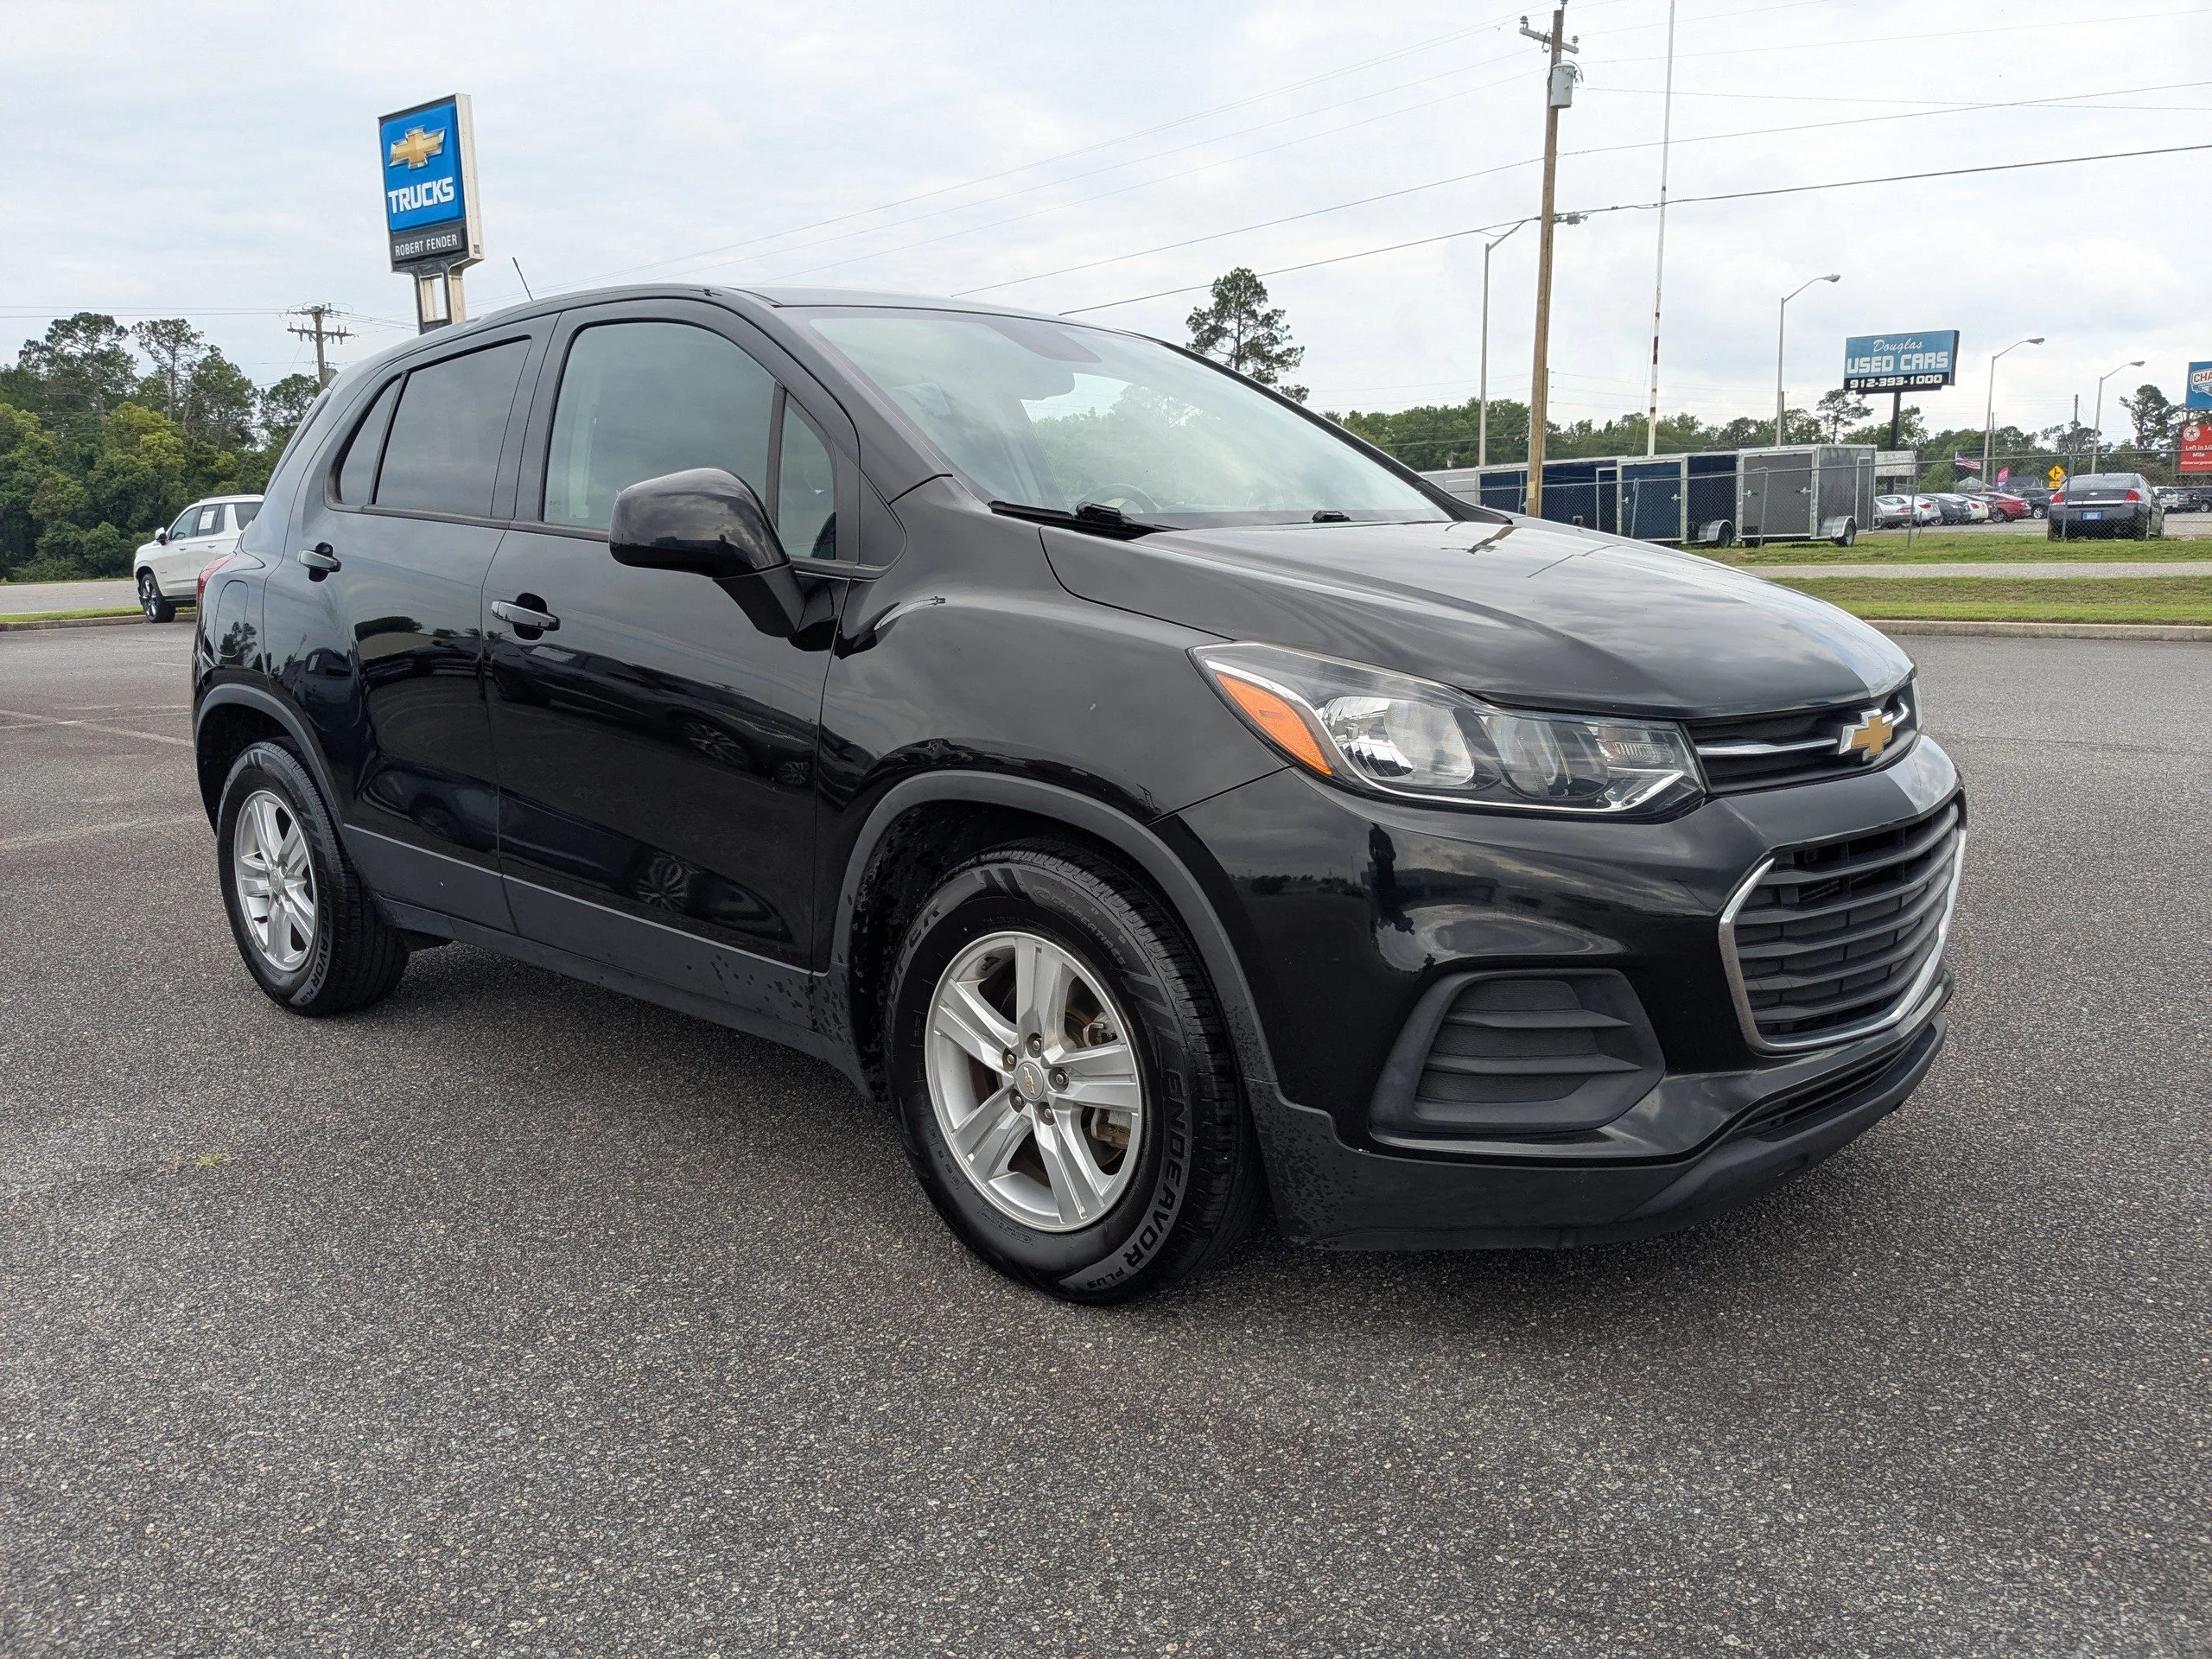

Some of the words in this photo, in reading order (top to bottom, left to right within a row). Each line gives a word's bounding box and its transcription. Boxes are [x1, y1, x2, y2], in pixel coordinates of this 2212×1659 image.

[388, 176, 454, 214] TRUCKS
[395, 239, 423, 257] ROBERT
[426, 233, 458, 250] FENDER
[1873, 338, 1923, 353] Douglas
[1847, 355, 1894, 374] USED
[1900, 351, 1948, 371] CARS
[1122, 1069, 1188, 1269] ENDEAVOR
[1086, 1265, 1125, 1289] PLUS
